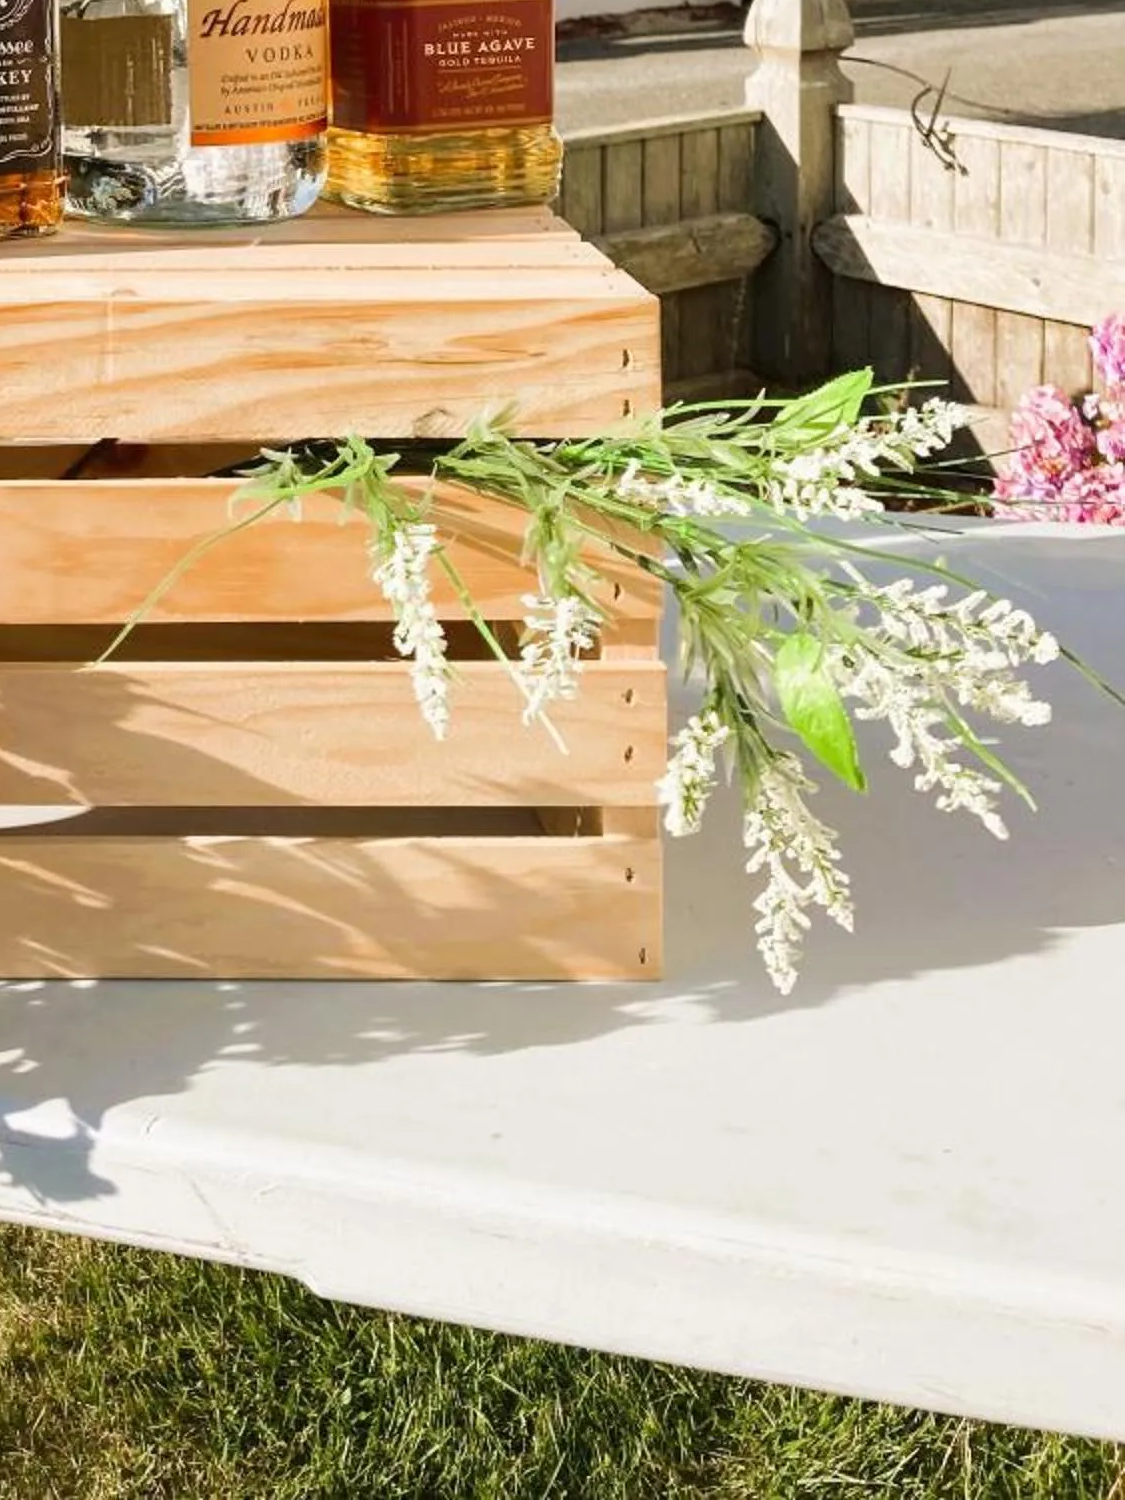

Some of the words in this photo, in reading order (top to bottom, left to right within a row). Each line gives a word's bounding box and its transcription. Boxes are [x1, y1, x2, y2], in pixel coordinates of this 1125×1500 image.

[246, 43, 314, 63] VODKA
[424, 41, 471, 56] BLUE
[477, 37, 535, 53] AGAVE
